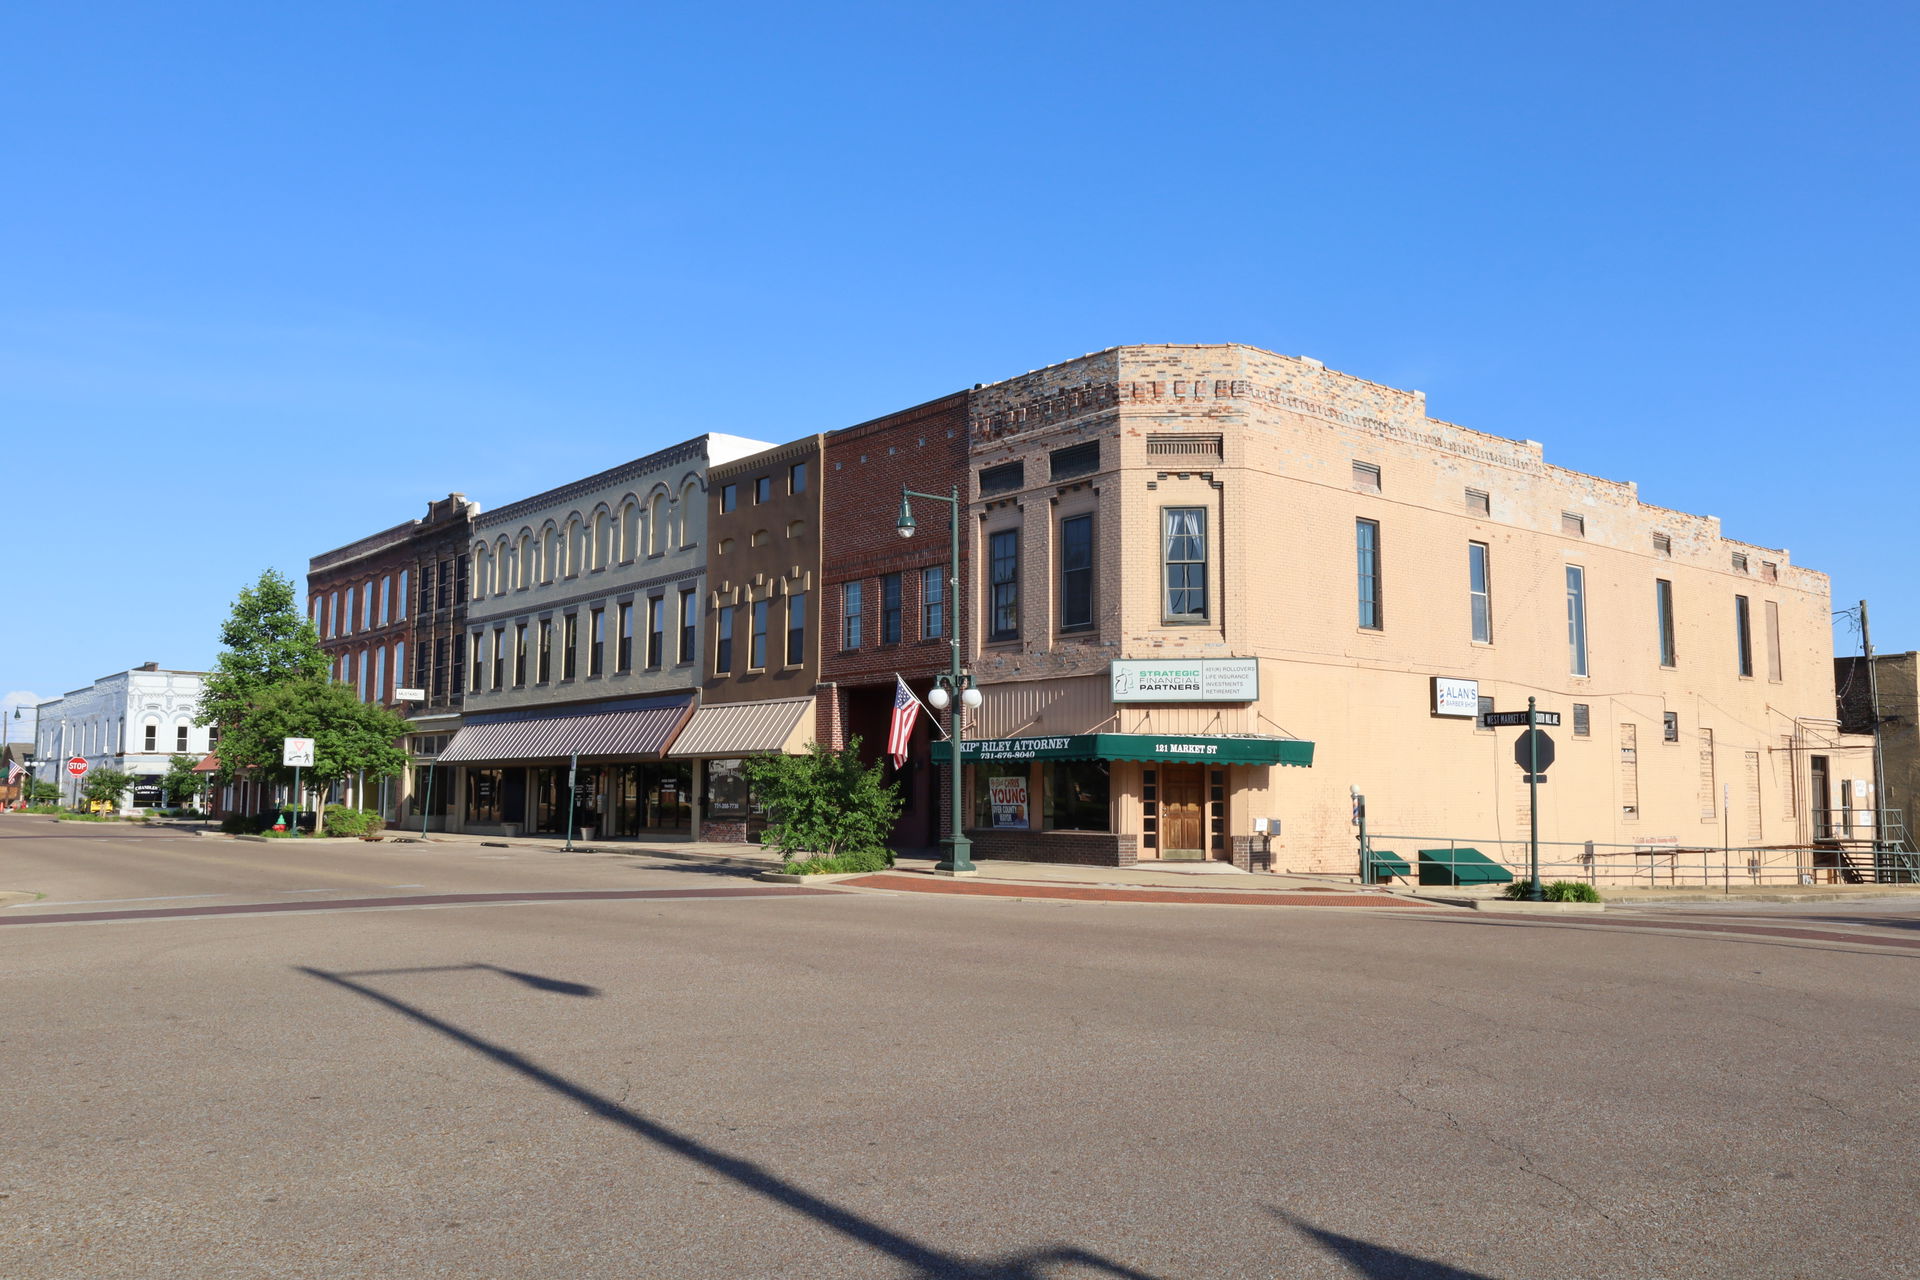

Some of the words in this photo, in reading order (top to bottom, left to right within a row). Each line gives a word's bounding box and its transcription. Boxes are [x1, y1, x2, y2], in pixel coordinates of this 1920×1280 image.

[1446, 687, 1476, 700] ALAN'S
[1486, 714, 1500, 725] WEST
[1500, 713, 1520, 724] MARKET
[982, 740, 1011, 752] RILEY
[1013, 738, 1070, 751] ATTORNEY
[1155, 744, 1168, 752] 121
[1170, 744, 1205, 754] MARKET
[1206, 745, 1218, 754] ST
[980, 751, 1035, 759] 731-676-8040
[68, 762, 87, 770] STOP
[991, 788, 1026, 804] YOUNG
